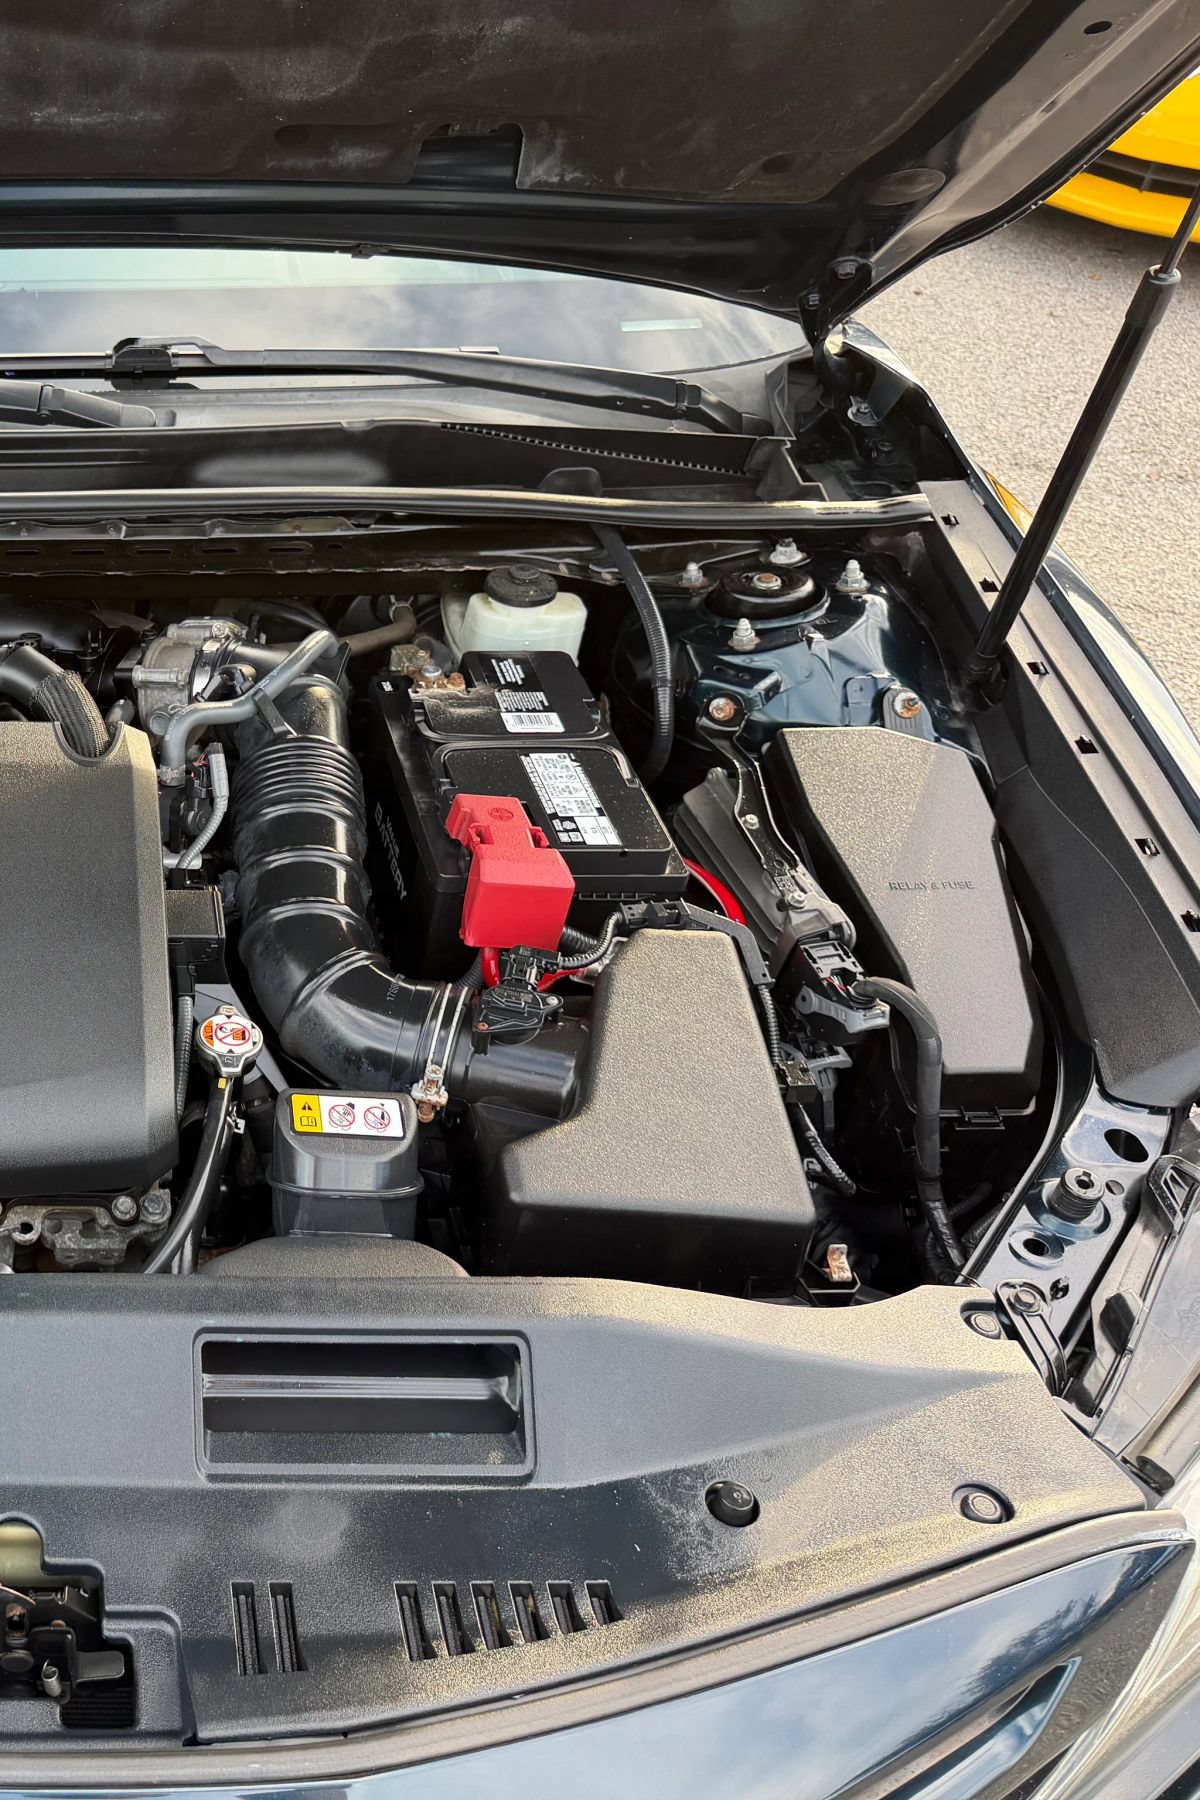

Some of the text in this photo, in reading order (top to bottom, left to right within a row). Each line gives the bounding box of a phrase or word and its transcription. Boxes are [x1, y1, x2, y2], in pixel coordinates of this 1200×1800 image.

[374, 801, 407, 900] BATTERY
[888, 881, 976, 890] RELAY & FUSE
